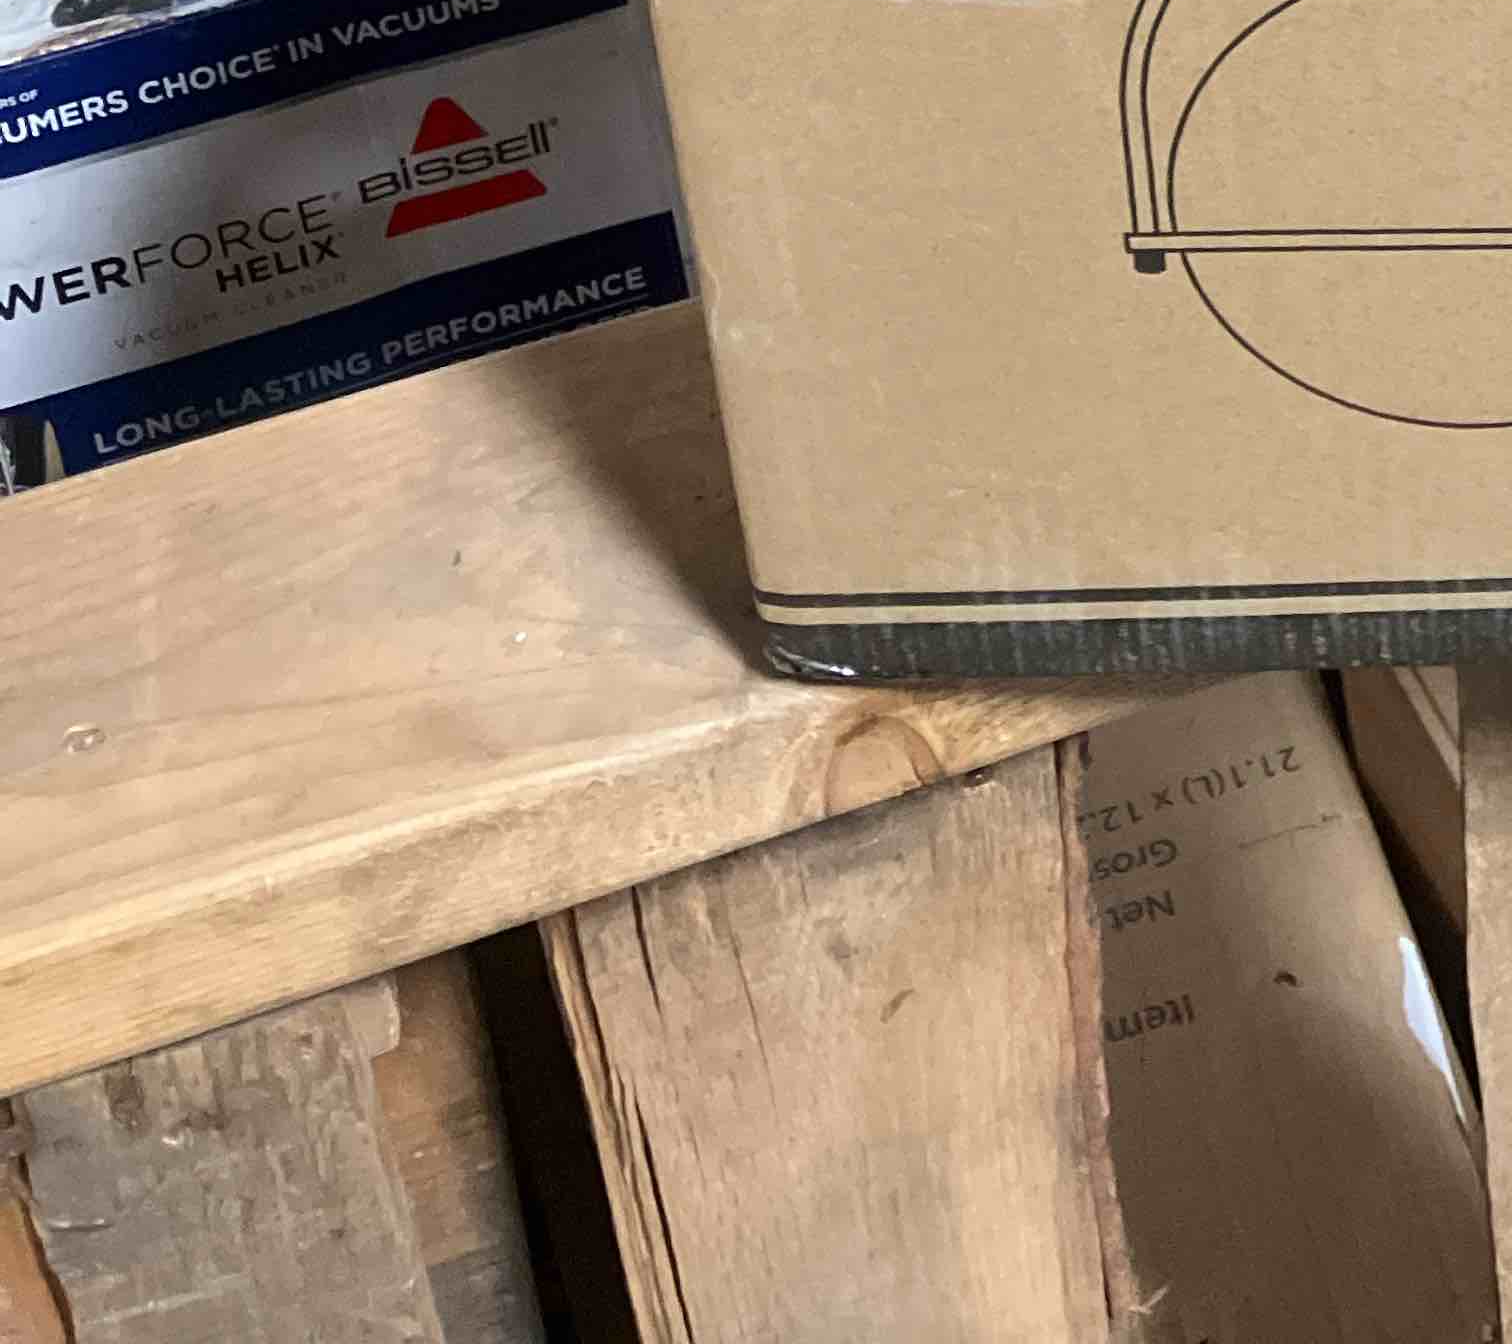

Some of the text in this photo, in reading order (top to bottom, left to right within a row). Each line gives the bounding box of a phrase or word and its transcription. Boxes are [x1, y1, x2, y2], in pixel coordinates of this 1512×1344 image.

[0, 89, 129, 144] UMERS
[288, 31, 325, 64] IN
[215, 233, 342, 293] HELIX
[382, 265, 648, 365] PERFORMANCE
[1103, 889, 1176, 932] Net
